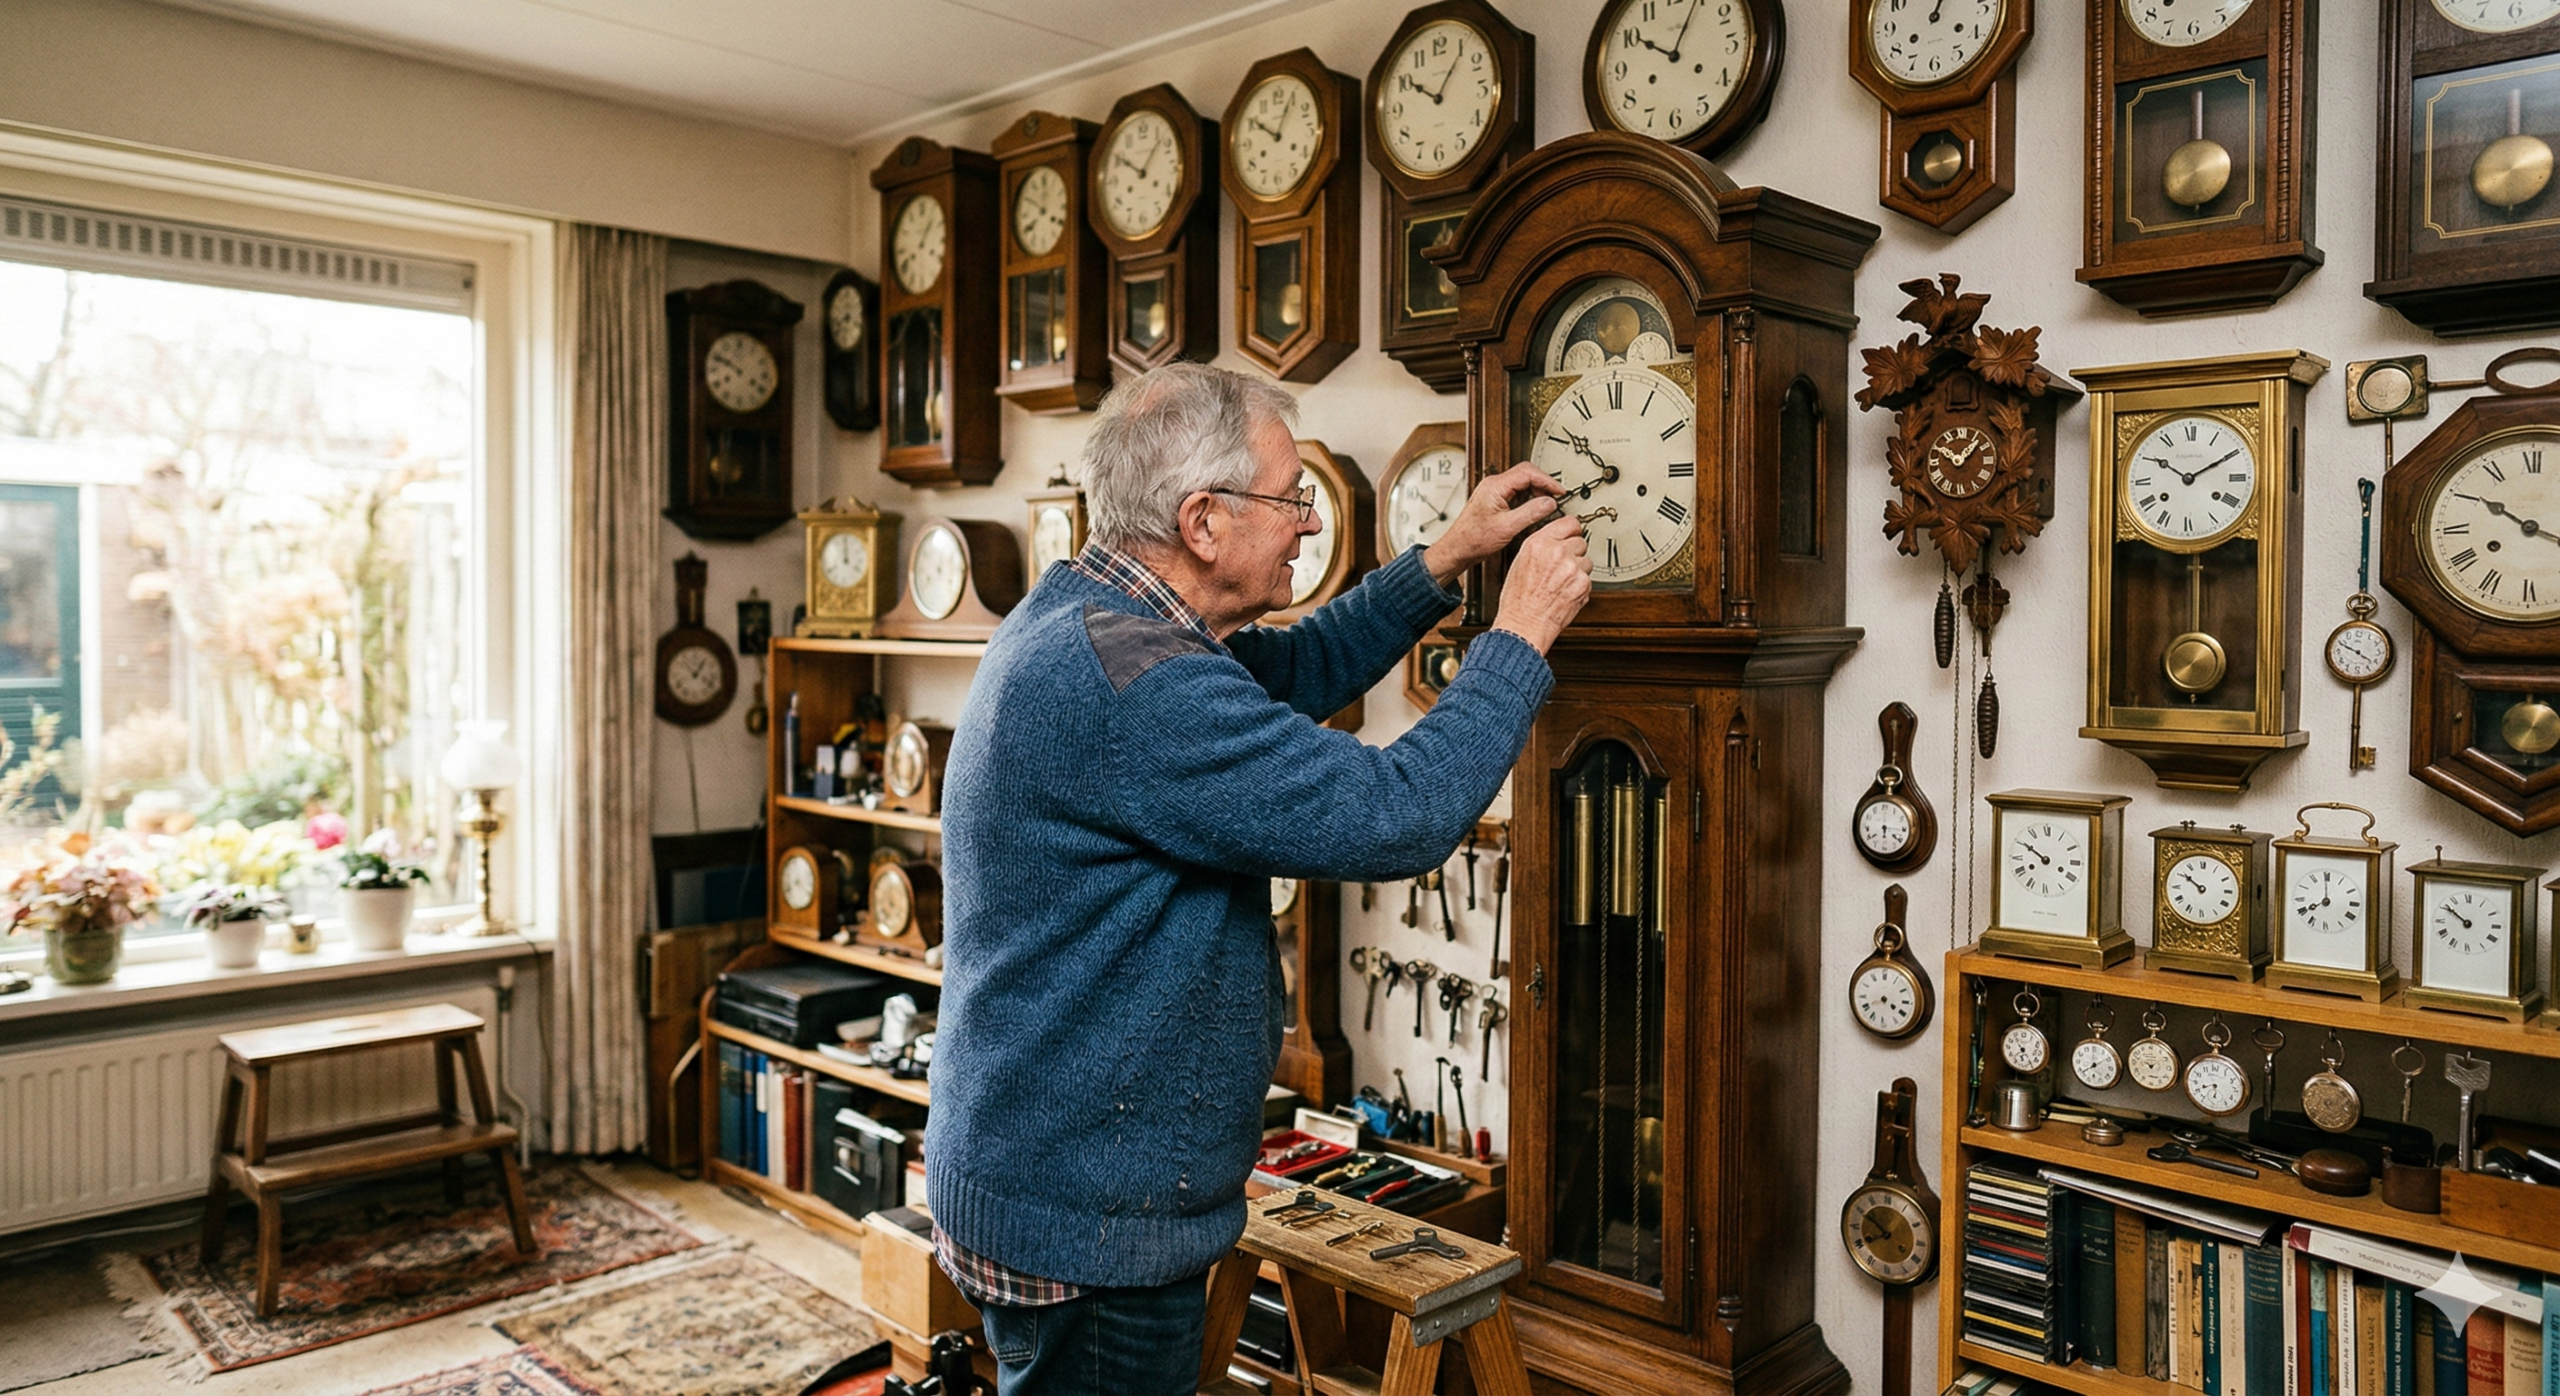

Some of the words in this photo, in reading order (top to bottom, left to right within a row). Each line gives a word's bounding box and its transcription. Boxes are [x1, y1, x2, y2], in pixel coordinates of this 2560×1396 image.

[2144, 7, 2157, 23] 8
[2213, 8, 2226, 25] 5
[2476, 0, 2491, 18] 7
[2508, 0, 2522, 19] 6
[1884, 21, 1896, 37] 9
[1967, 24, 1983, 39] 4
[2164, 19, 2175, 36] 7
[2187, 20, 2199, 36] 6
[1433, 36, 1447, 56] 12
[1623, 26, 1640, 48] 10
[1415, 50, 1424, 68] 11
[1890, 42, 1902, 59] 8
[1951, 44, 1963, 62] 5
[1615, 61, 1627, 81] 9
[1908, 53, 1918, 71] 7
[1929, 55, 1940, 72] 6
[1399, 73, 1412, 93] 10
[1715, 67, 1731, 87] 4
[1623, 89, 1636, 109] 8
[1696, 94, 1709, 116] 5
[1393, 102, 1403, 119] 9
[1470, 109, 1484, 127] 4
[1644, 107, 1656, 127] 7
[1669, 108, 1682, 129] 6
[1399, 125, 1410, 144] 8
[1455, 132, 1466, 150] 5
[1416, 141, 1425, 159] 7
[1434, 143, 1444, 161] 6
[1605, 381, 1623, 412] XII
[1640, 390, 1655, 417] I
[1660, 419, 1685, 441] II
[1438, 460, 1452, 475] 12
[1668, 462, 1694, 478] III
[2521, 451, 2541, 474] XII
[1422, 467, 1430, 481] 11
